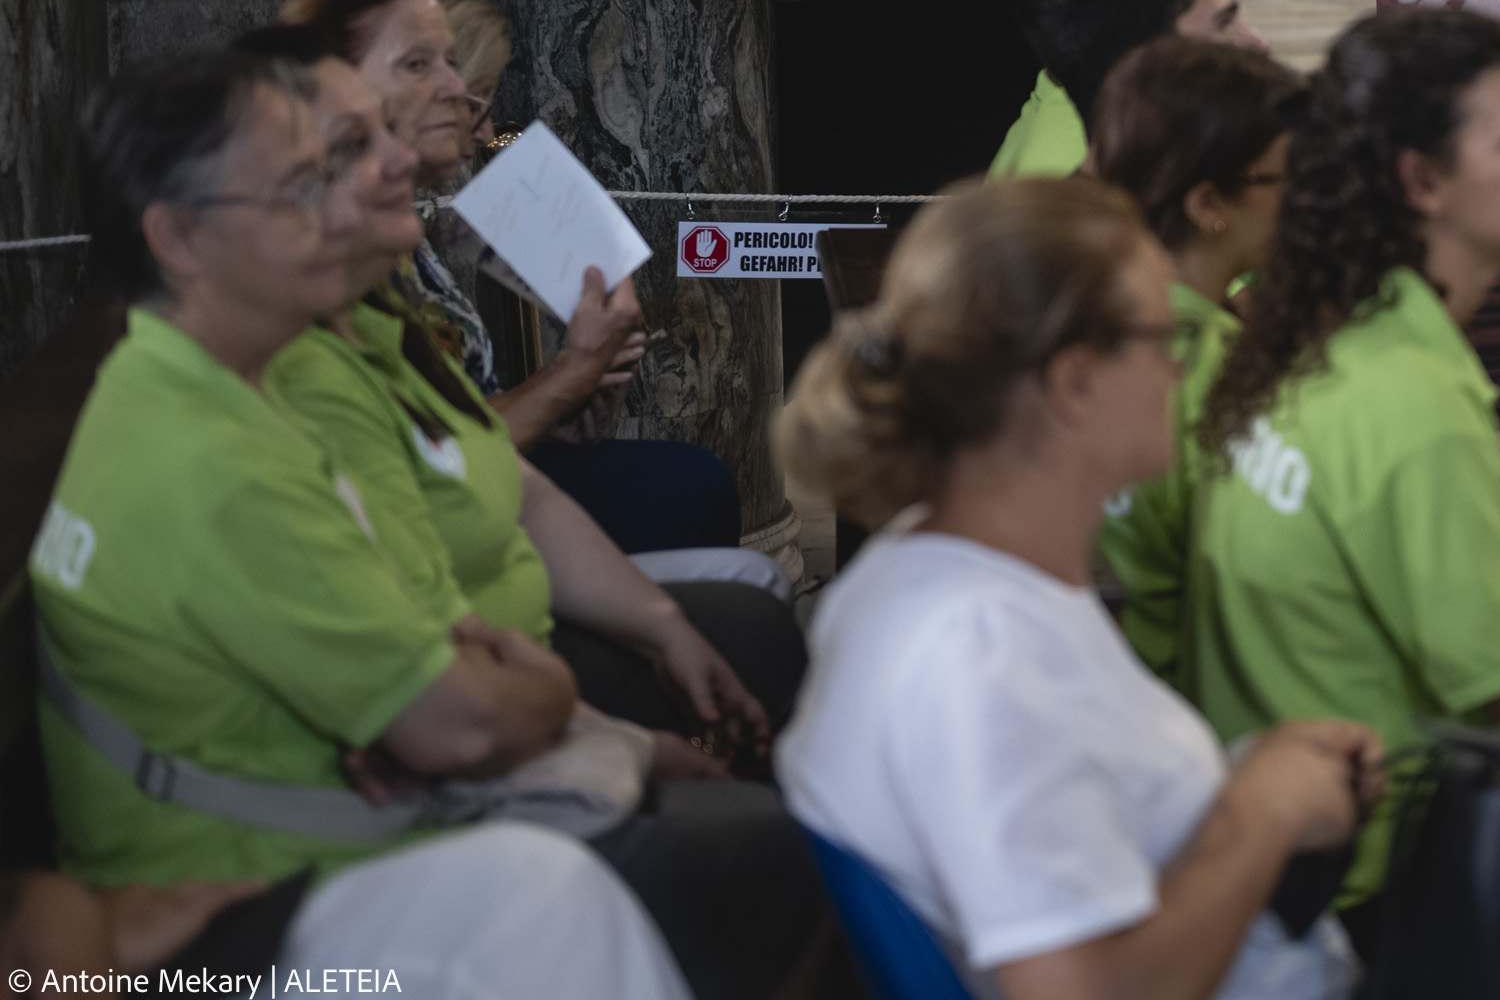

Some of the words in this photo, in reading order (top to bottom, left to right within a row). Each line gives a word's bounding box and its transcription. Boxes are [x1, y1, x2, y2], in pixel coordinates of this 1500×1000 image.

[734, 231, 814, 249] PERICOLO!
[693, 258, 717, 268] STOP
[740, 255, 804, 273] GEFAHR!
